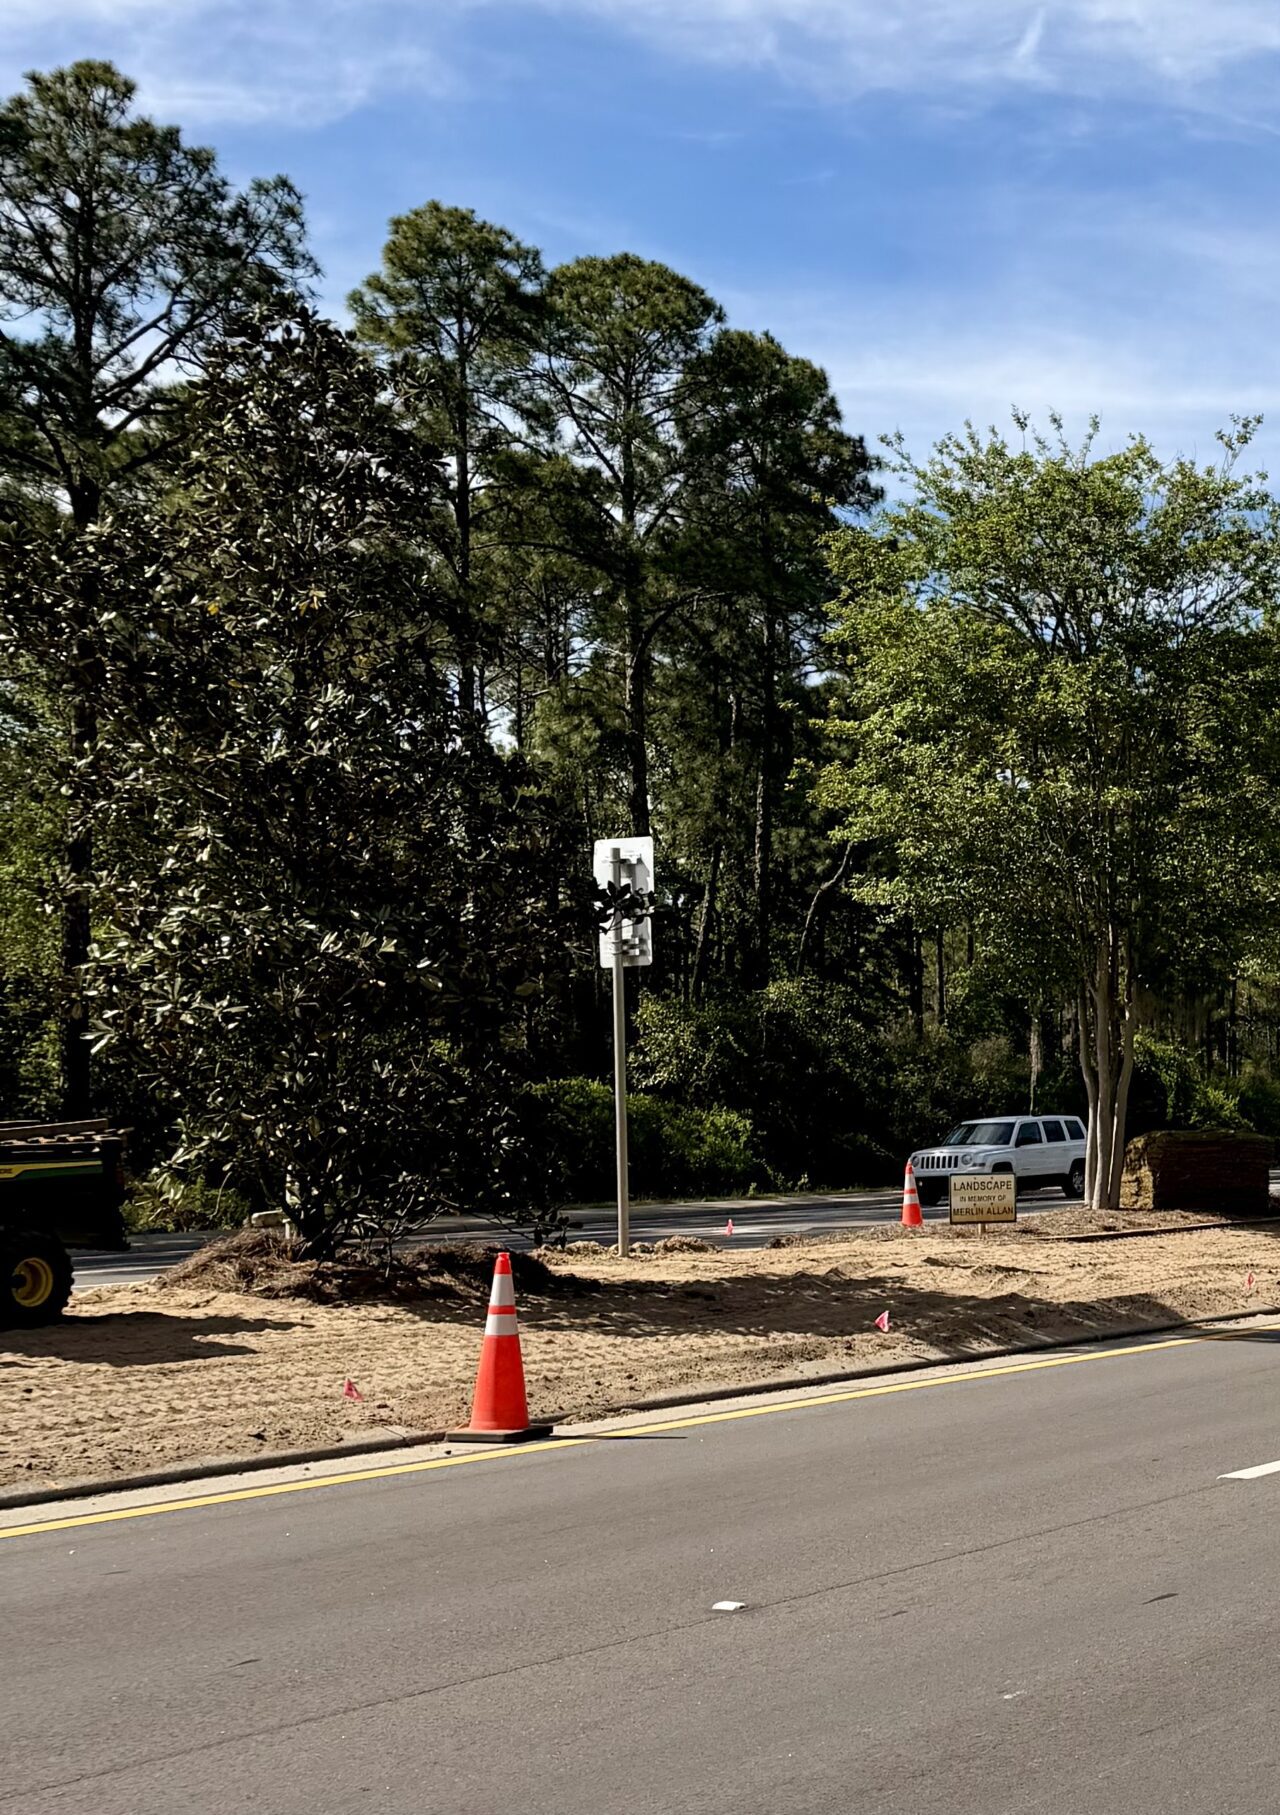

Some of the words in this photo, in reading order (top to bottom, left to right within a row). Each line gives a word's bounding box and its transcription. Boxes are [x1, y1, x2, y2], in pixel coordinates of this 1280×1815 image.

[953, 1180, 1012, 1191] LANDSCAPE
[968, 1194, 996, 1202] MEMORY
[997, 1194, 1006, 1202] OF
[953, 1207, 983, 1216] MERLIN
[986, 1206, 1014, 1215] ALLAN
